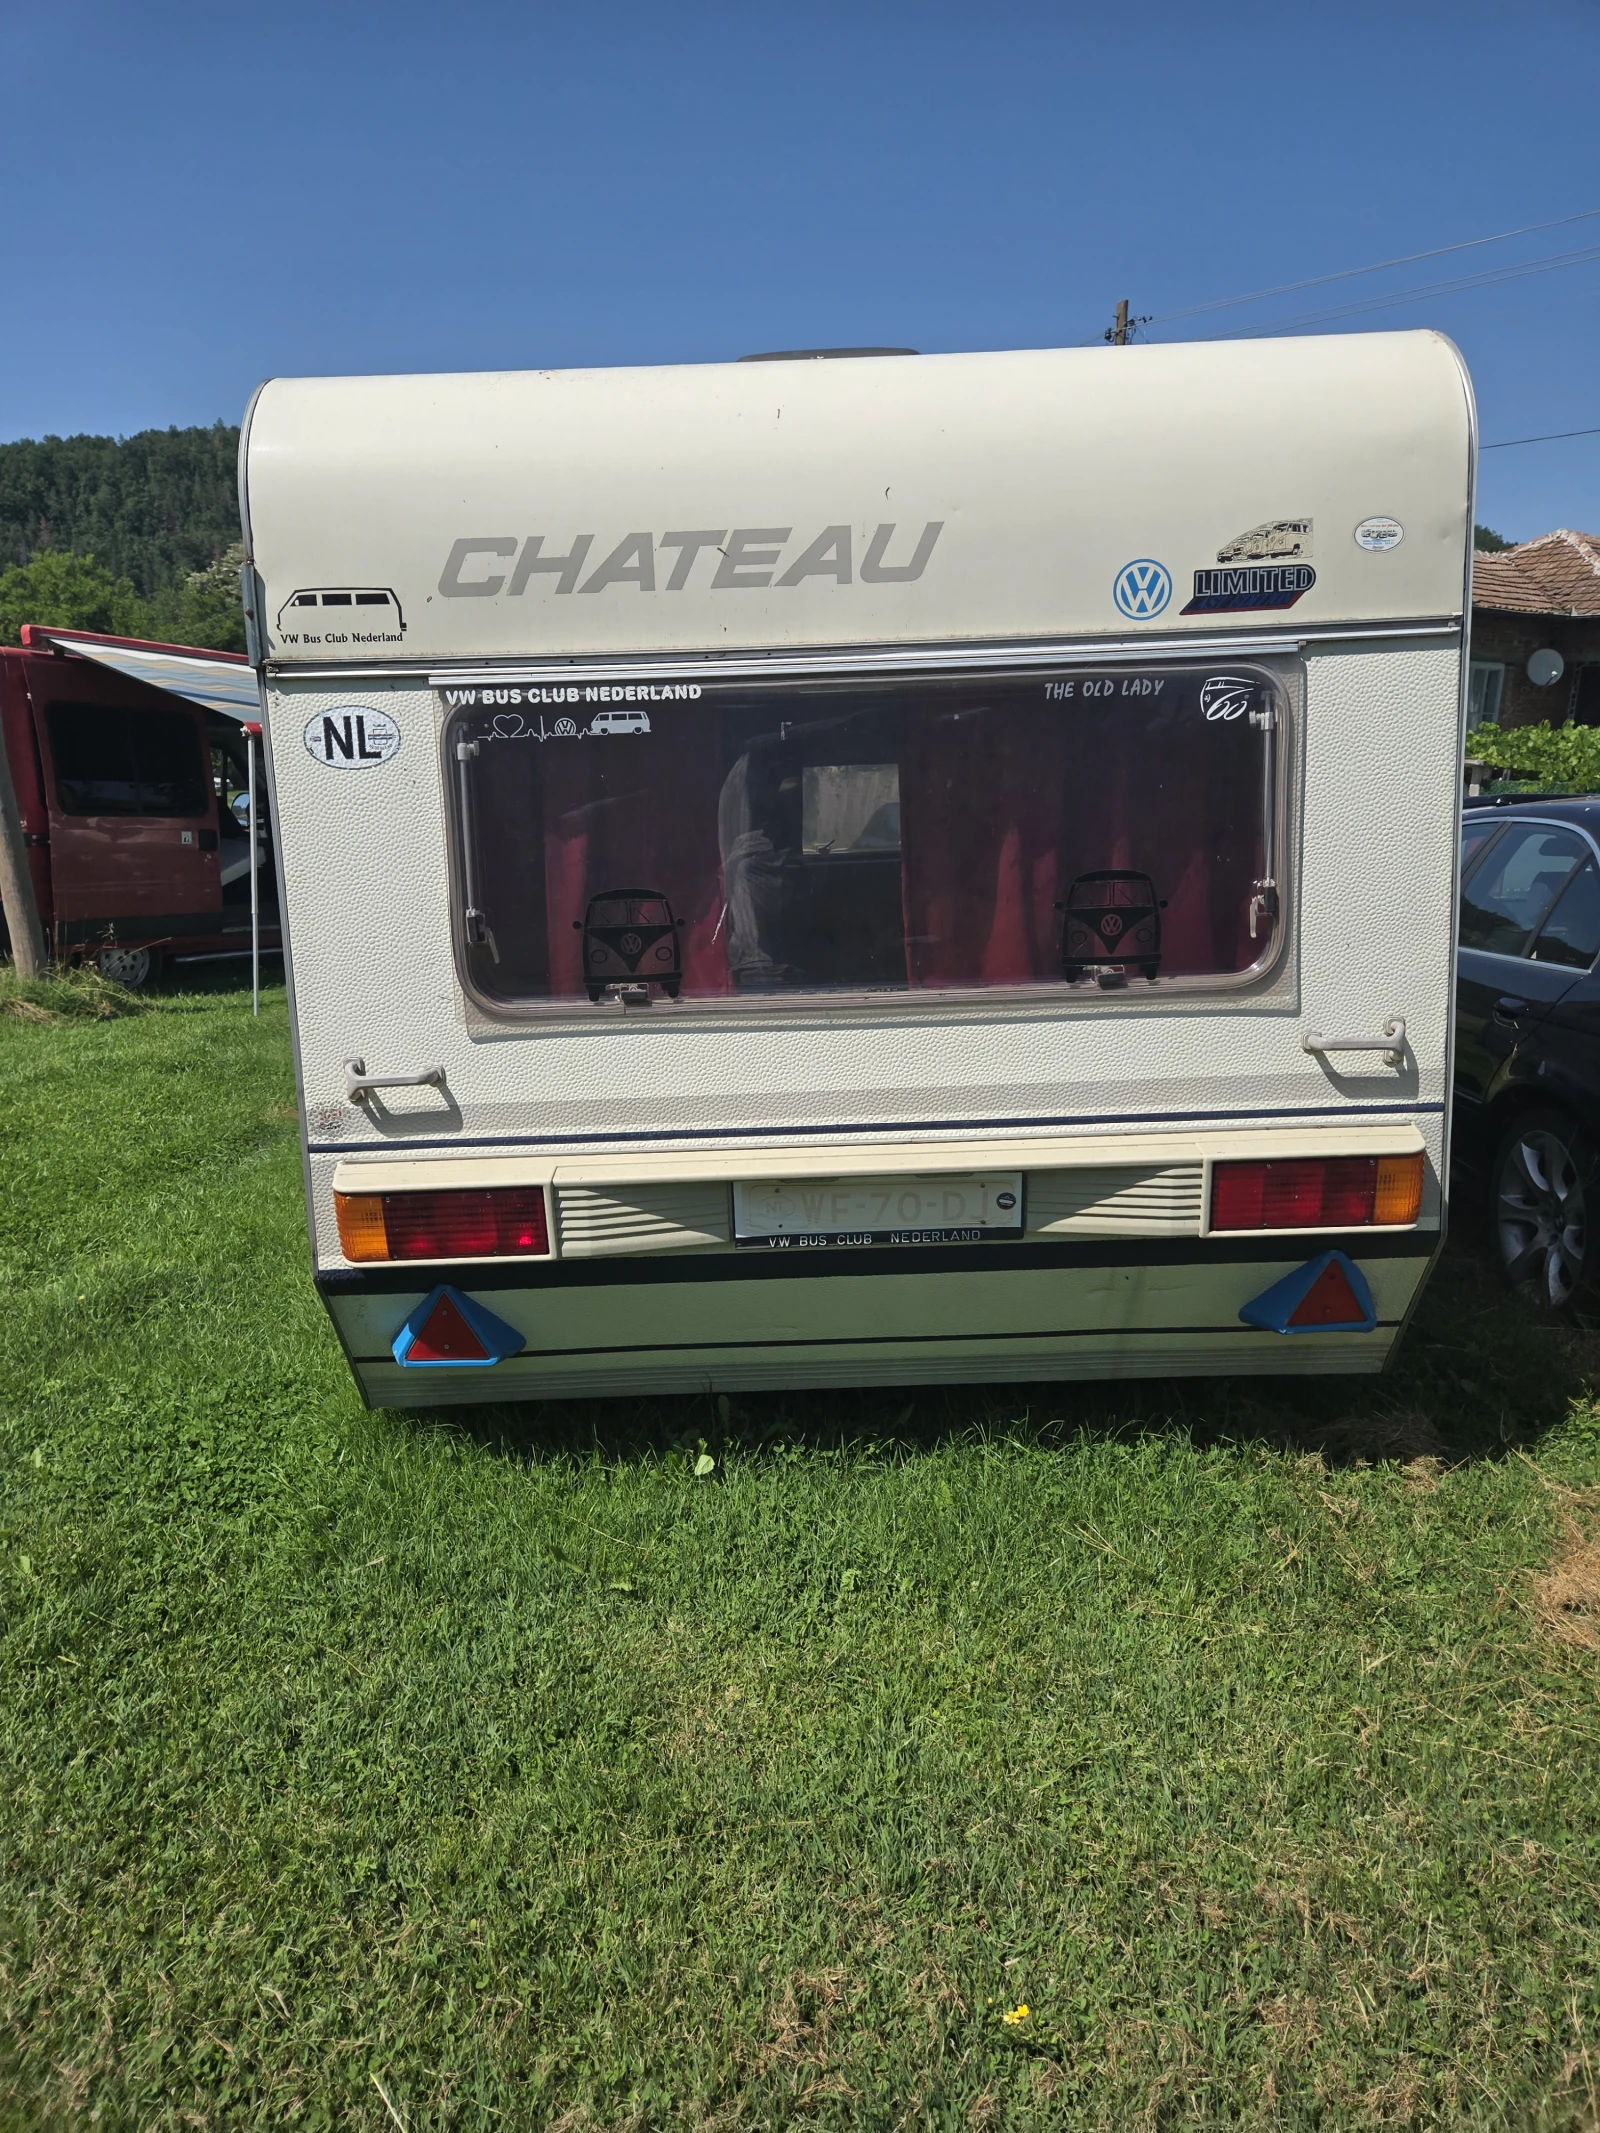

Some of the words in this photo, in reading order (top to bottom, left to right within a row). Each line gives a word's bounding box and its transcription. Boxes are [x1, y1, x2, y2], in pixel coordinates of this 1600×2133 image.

[437, 521, 945, 598] CHATEAU
[1116, 562, 1169, 617] VW
[1195, 566, 1315, 597] LIMITED
[280, 634, 299, 643] VW
[303, 634, 321, 643] Bus
[325, 633, 348, 643] Club
[351, 632, 403, 642] Nederland
[446, 690, 476, 705] VW
[482, 689, 522, 705] BUS
[528, 686, 580, 704] CLUB
[585, 684, 702, 702] NEDERLAND
[1044, 682, 1074, 700] THE
[1082, 680, 1114, 697] OLD
[1121, 679, 1165, 696] LADY
[323, 715, 382, 760] NL
[1102, 914, 1122, 936] VW
[621, 933, 642, 955] VW
[769, 1236, 791, 1248] VW
[800, 1235, 827, 1247] BUS
[837, 1233, 872, 1246] CLUB
[890, 1230, 981, 1244] NEDERLAND
